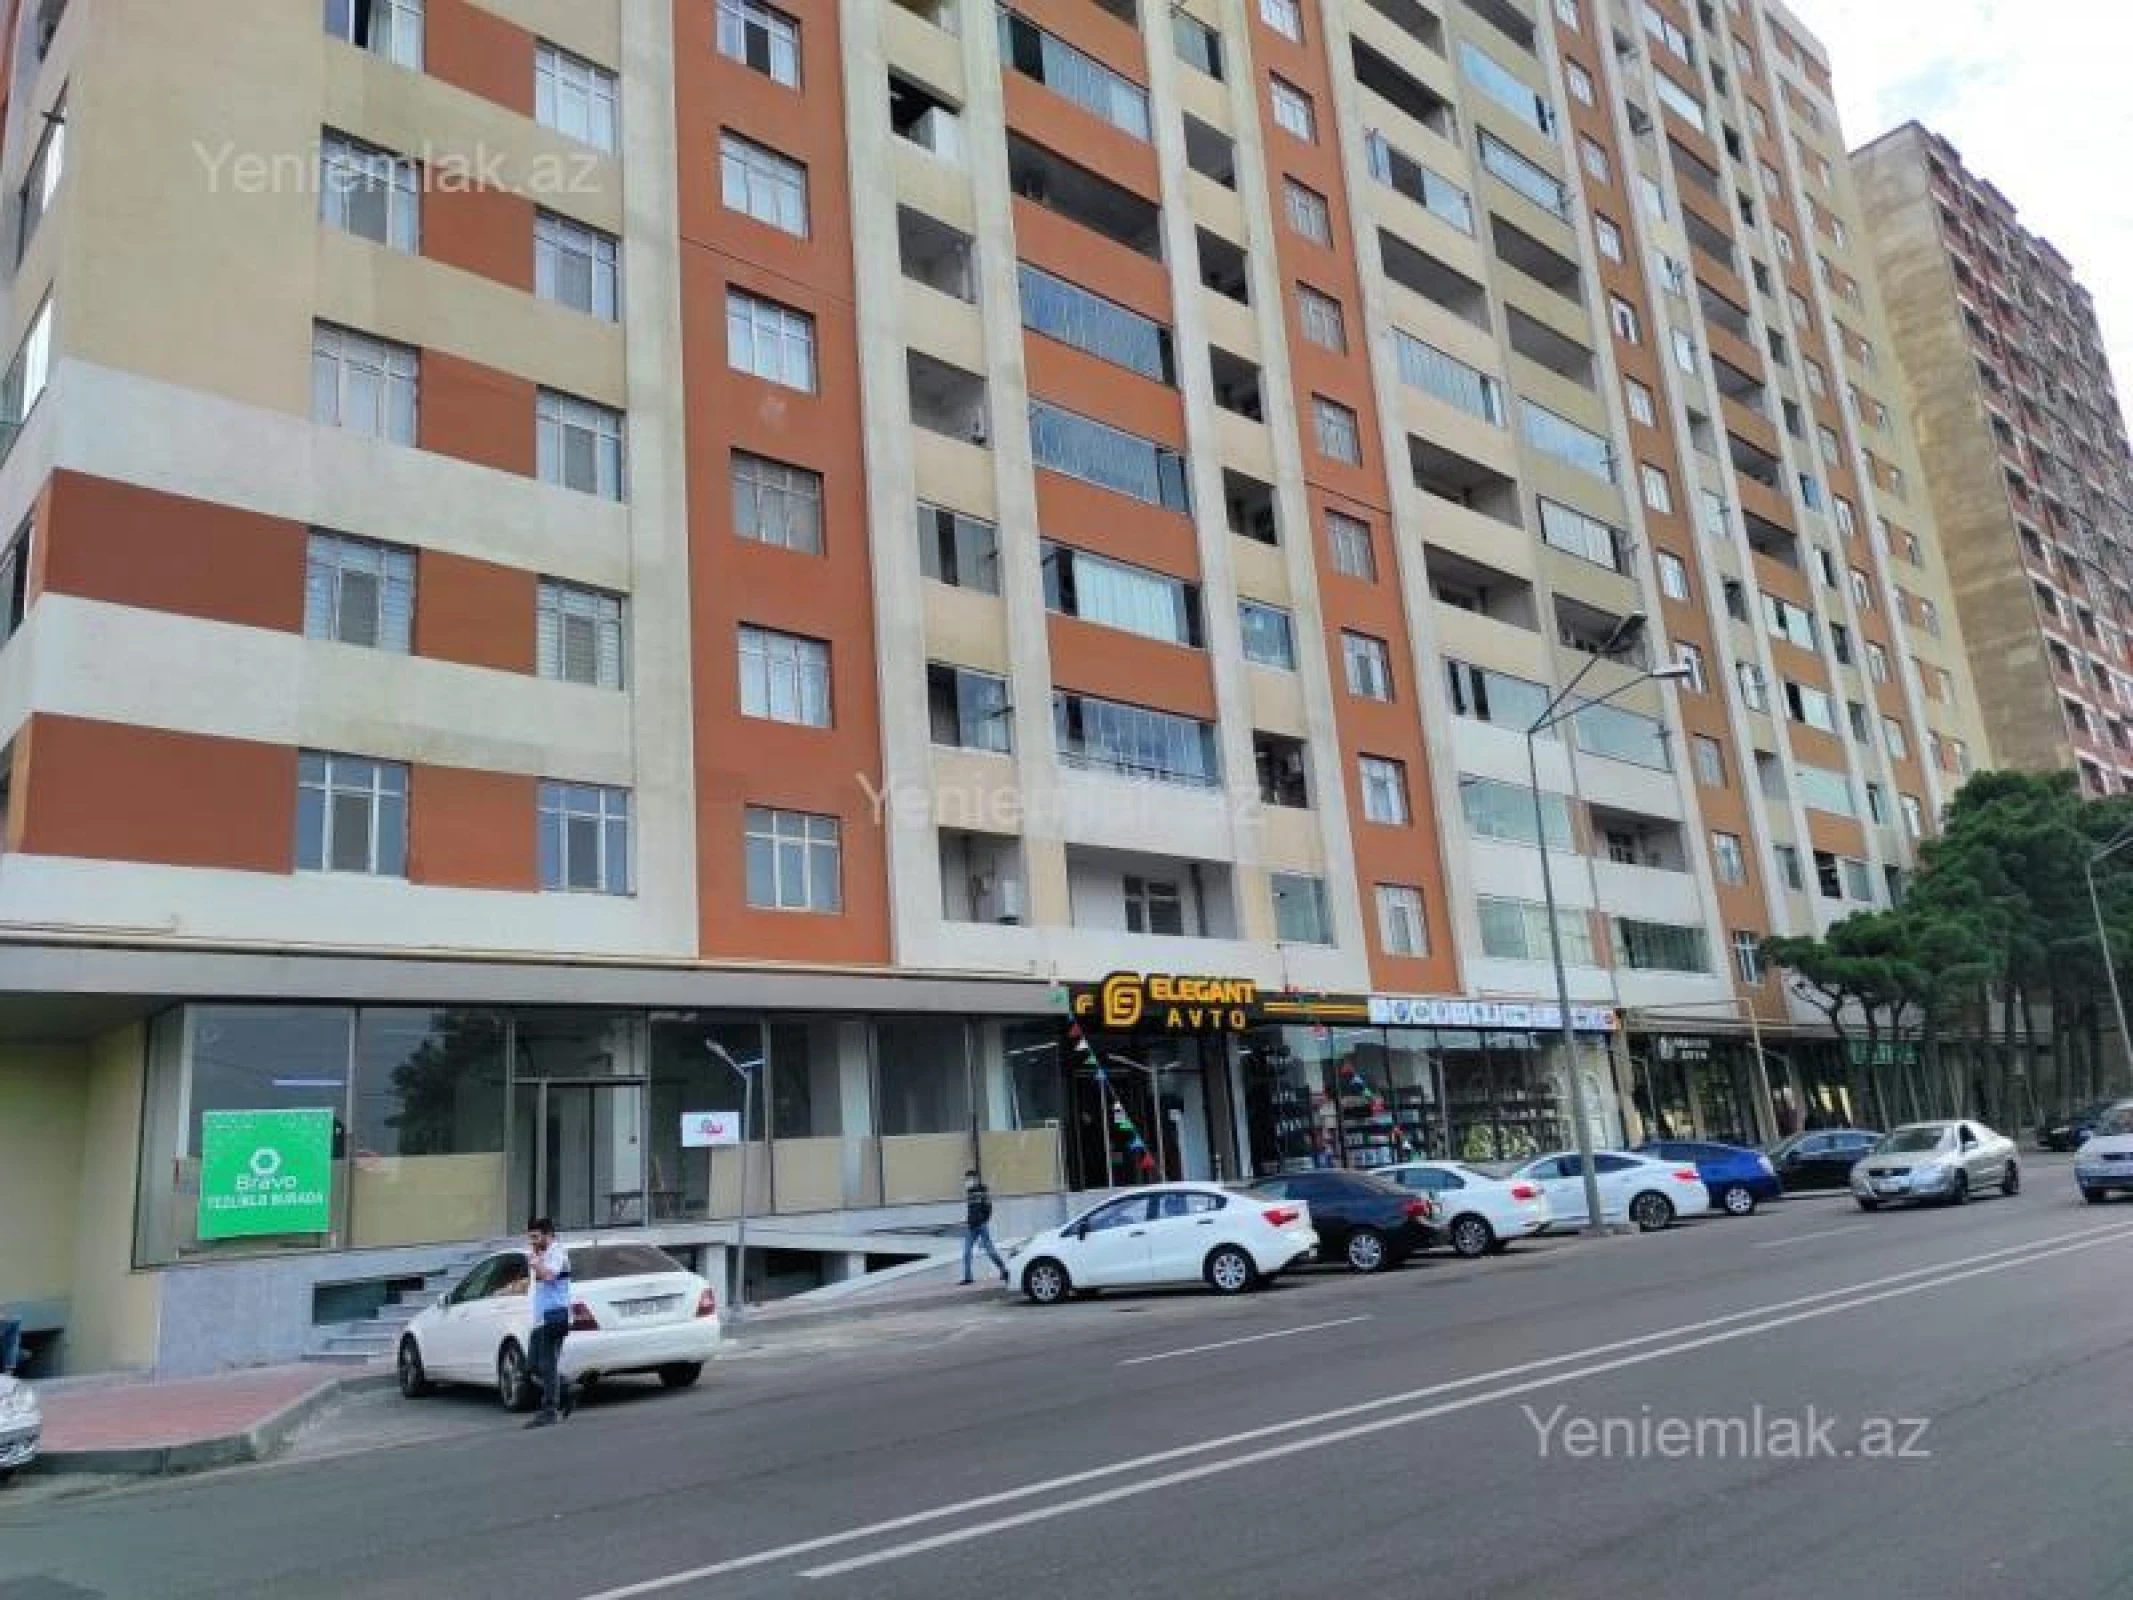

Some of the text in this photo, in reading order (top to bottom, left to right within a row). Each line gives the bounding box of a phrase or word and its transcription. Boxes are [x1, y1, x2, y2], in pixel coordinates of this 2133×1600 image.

[1150, 977, 1256, 1004] ELEGANT
[1166, 1007, 1247, 1029] AVTO
[236, 1173, 298, 1191] Bravo
